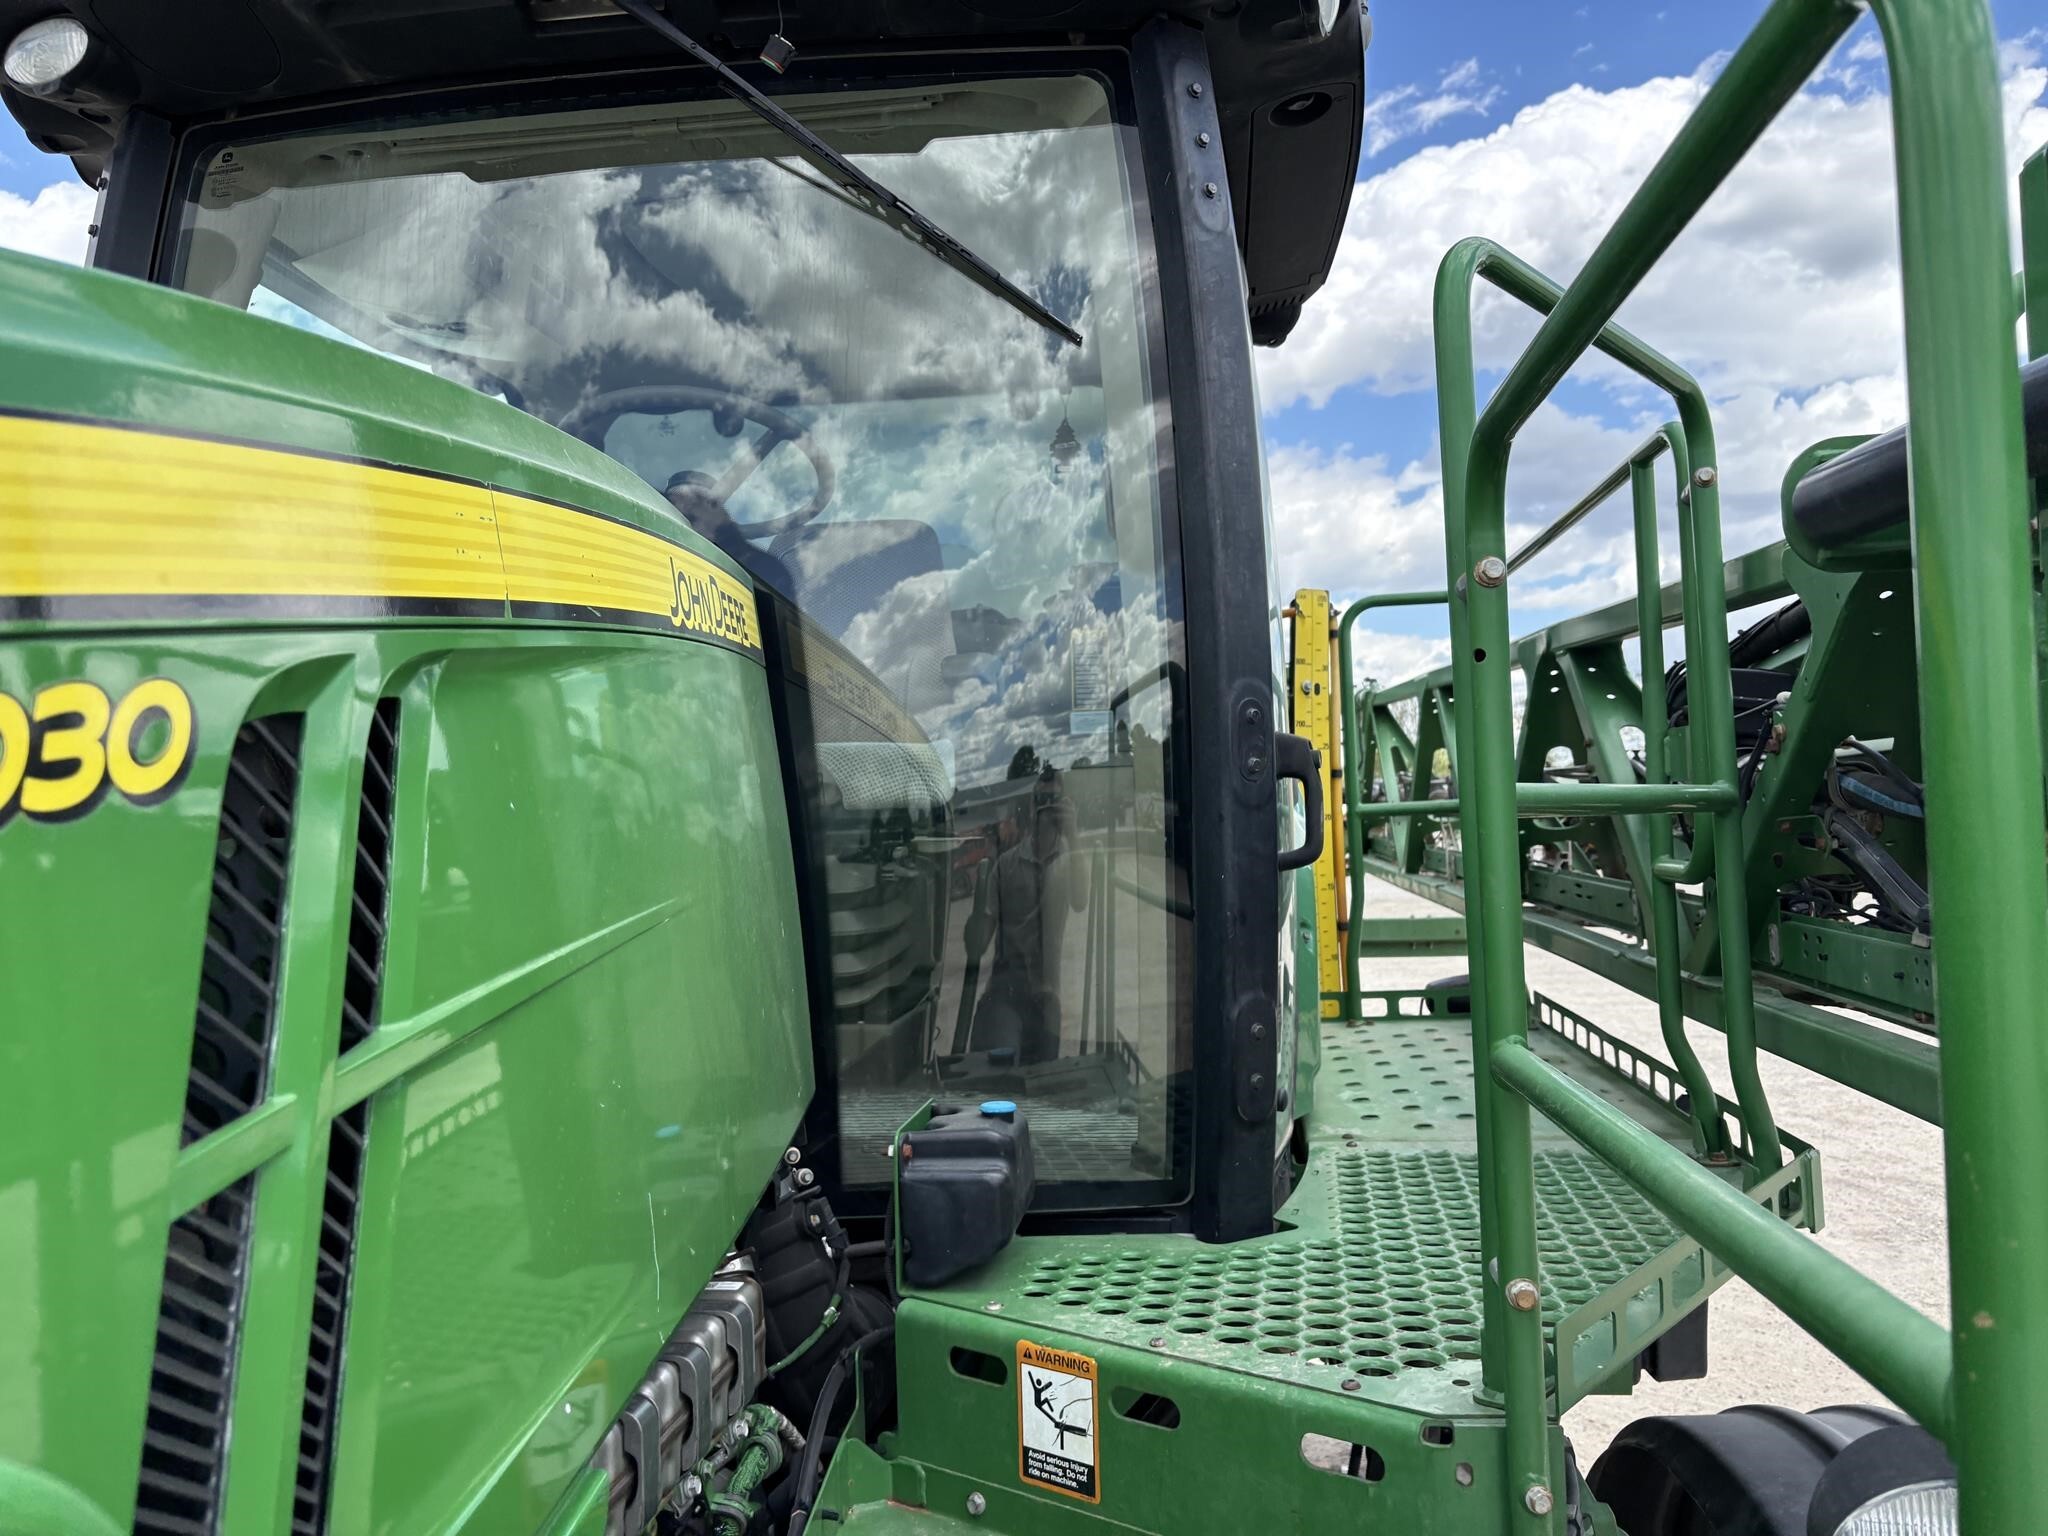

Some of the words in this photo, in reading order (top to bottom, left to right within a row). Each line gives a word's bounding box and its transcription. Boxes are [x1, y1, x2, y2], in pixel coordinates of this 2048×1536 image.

[668, 556, 713, 630] JOHN
[709, 574, 750, 642] DEERE
[1296, 720, 1306, 728] 700
[1035, 1350, 1090, 1373] WARNING
[1028, 1450, 1045, 1460] Avoid
[1046, 1456, 1069, 1468] serious
[1070, 1461, 1088, 1475] injury
[1028, 1458, 1043, 1469] from
[1043, 1462, 1064, 1476] falling.
[1066, 1469, 1076, 1478] Do
[1077, 1473, 1088, 1483] not
[1028, 1467, 1040, 1477] ride
[1051, 1474, 1079, 1488] machine.
